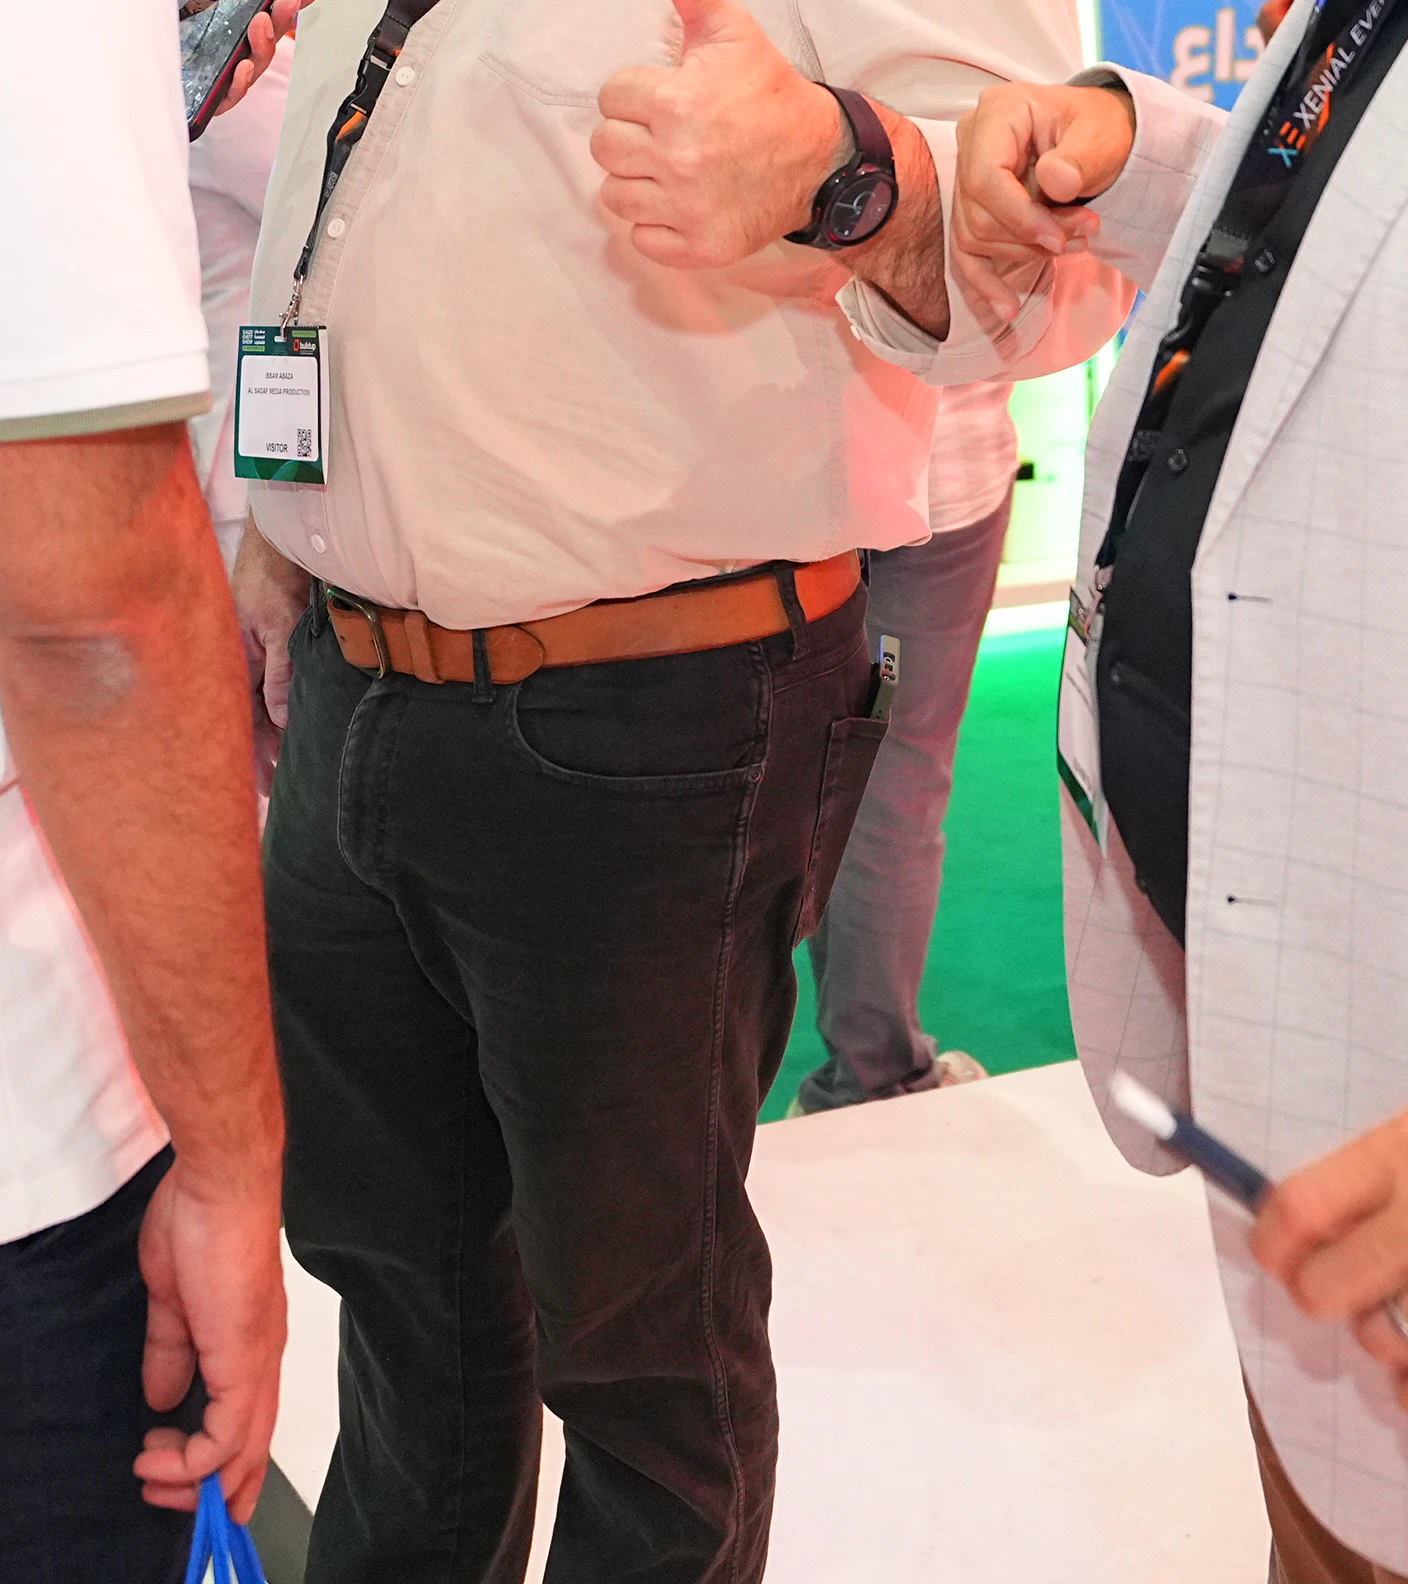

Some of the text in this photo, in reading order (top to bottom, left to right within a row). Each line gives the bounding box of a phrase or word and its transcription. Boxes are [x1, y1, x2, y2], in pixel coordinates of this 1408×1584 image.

[1293, 46, 1356, 130] XENIAL
[247, 387, 311, 396] AL SADAF MEDIA PRODUCTION
[265, 442, 288, 453] VISITOR
